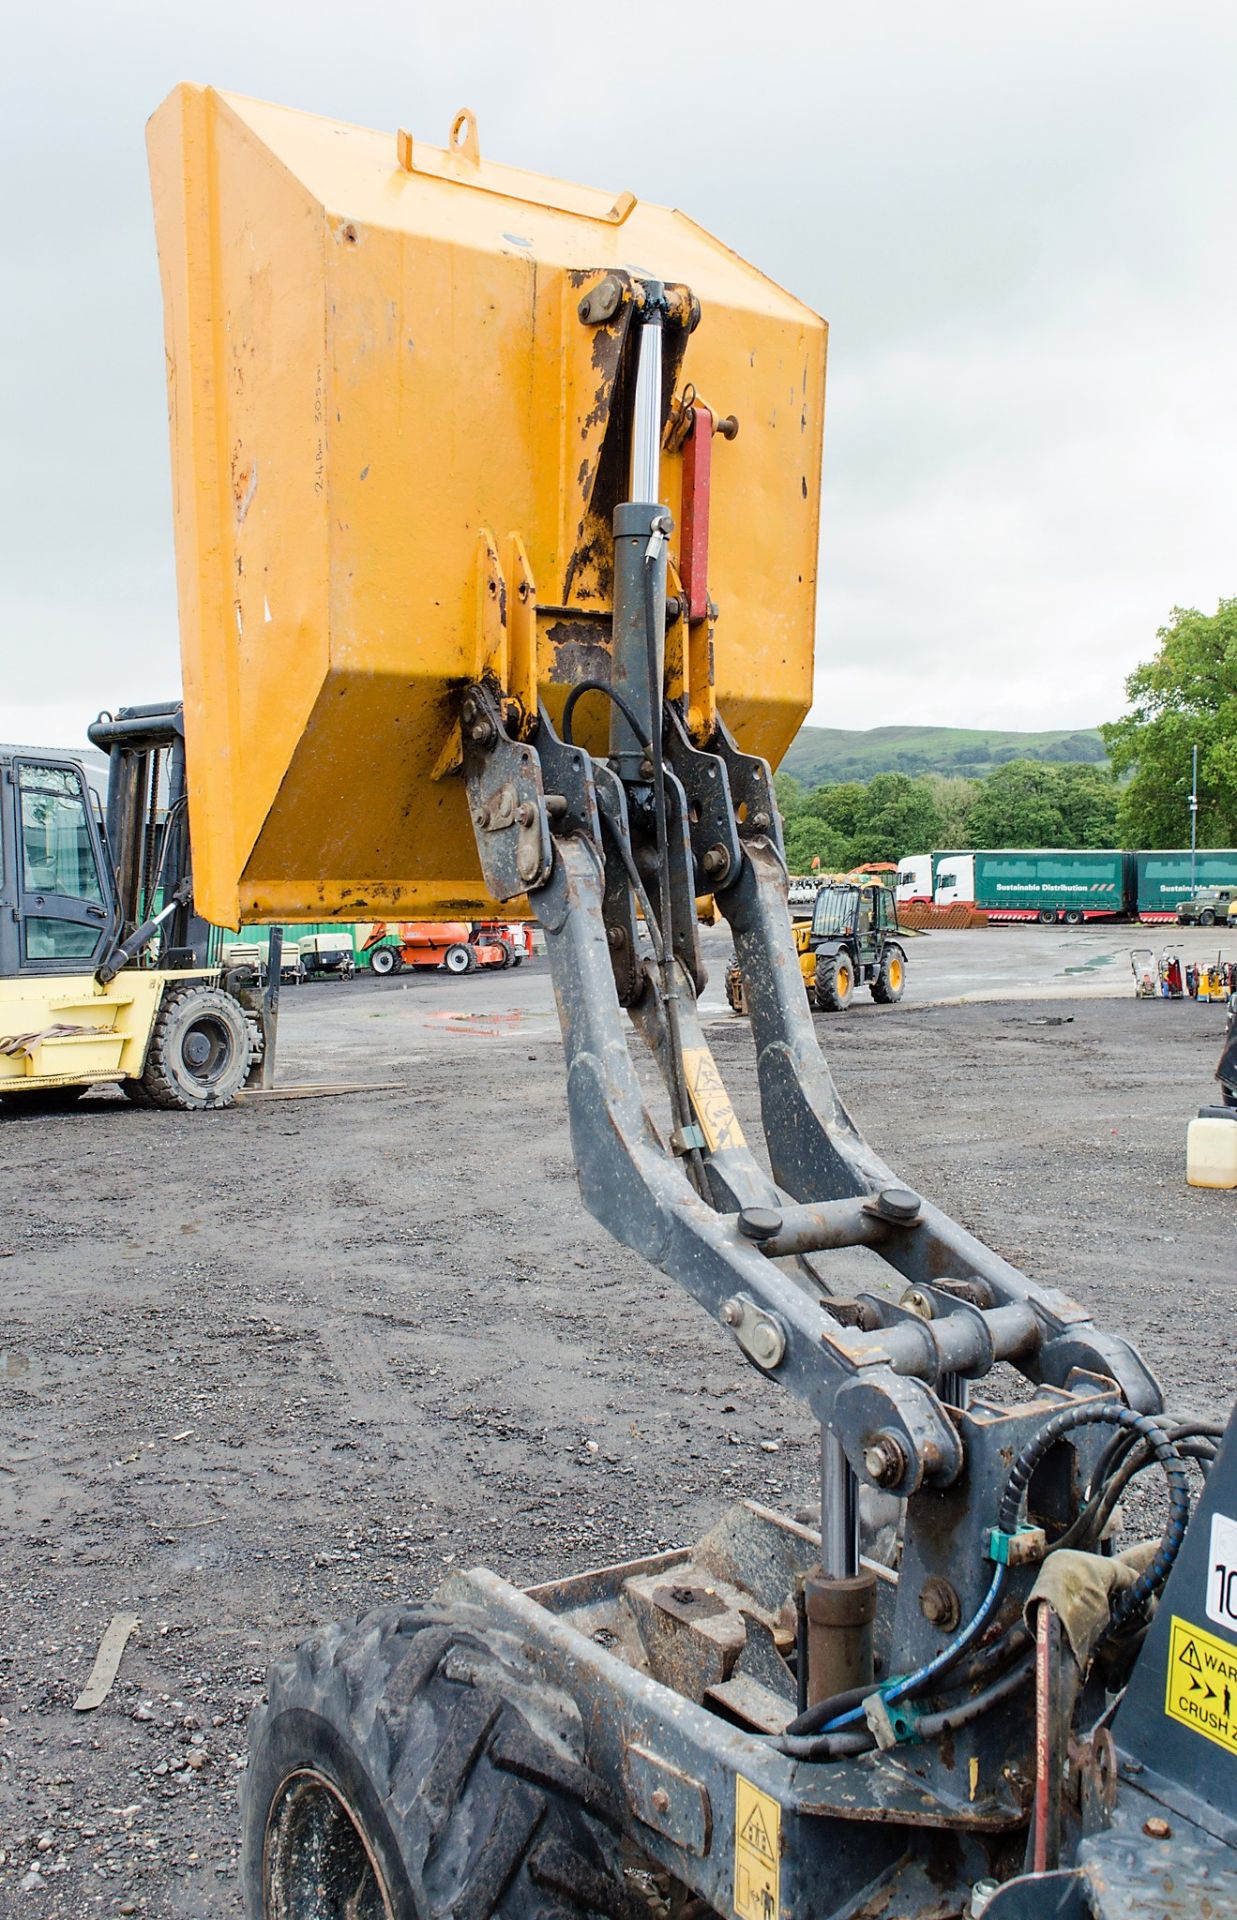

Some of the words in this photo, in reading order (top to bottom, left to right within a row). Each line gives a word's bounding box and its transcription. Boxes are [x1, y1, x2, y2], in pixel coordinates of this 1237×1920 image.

[996, 883, 1040, 892] Sustainable
[1041, 883, 1088, 892] Distribution
[1178, 1696, 1228, 1735] CRUSH
